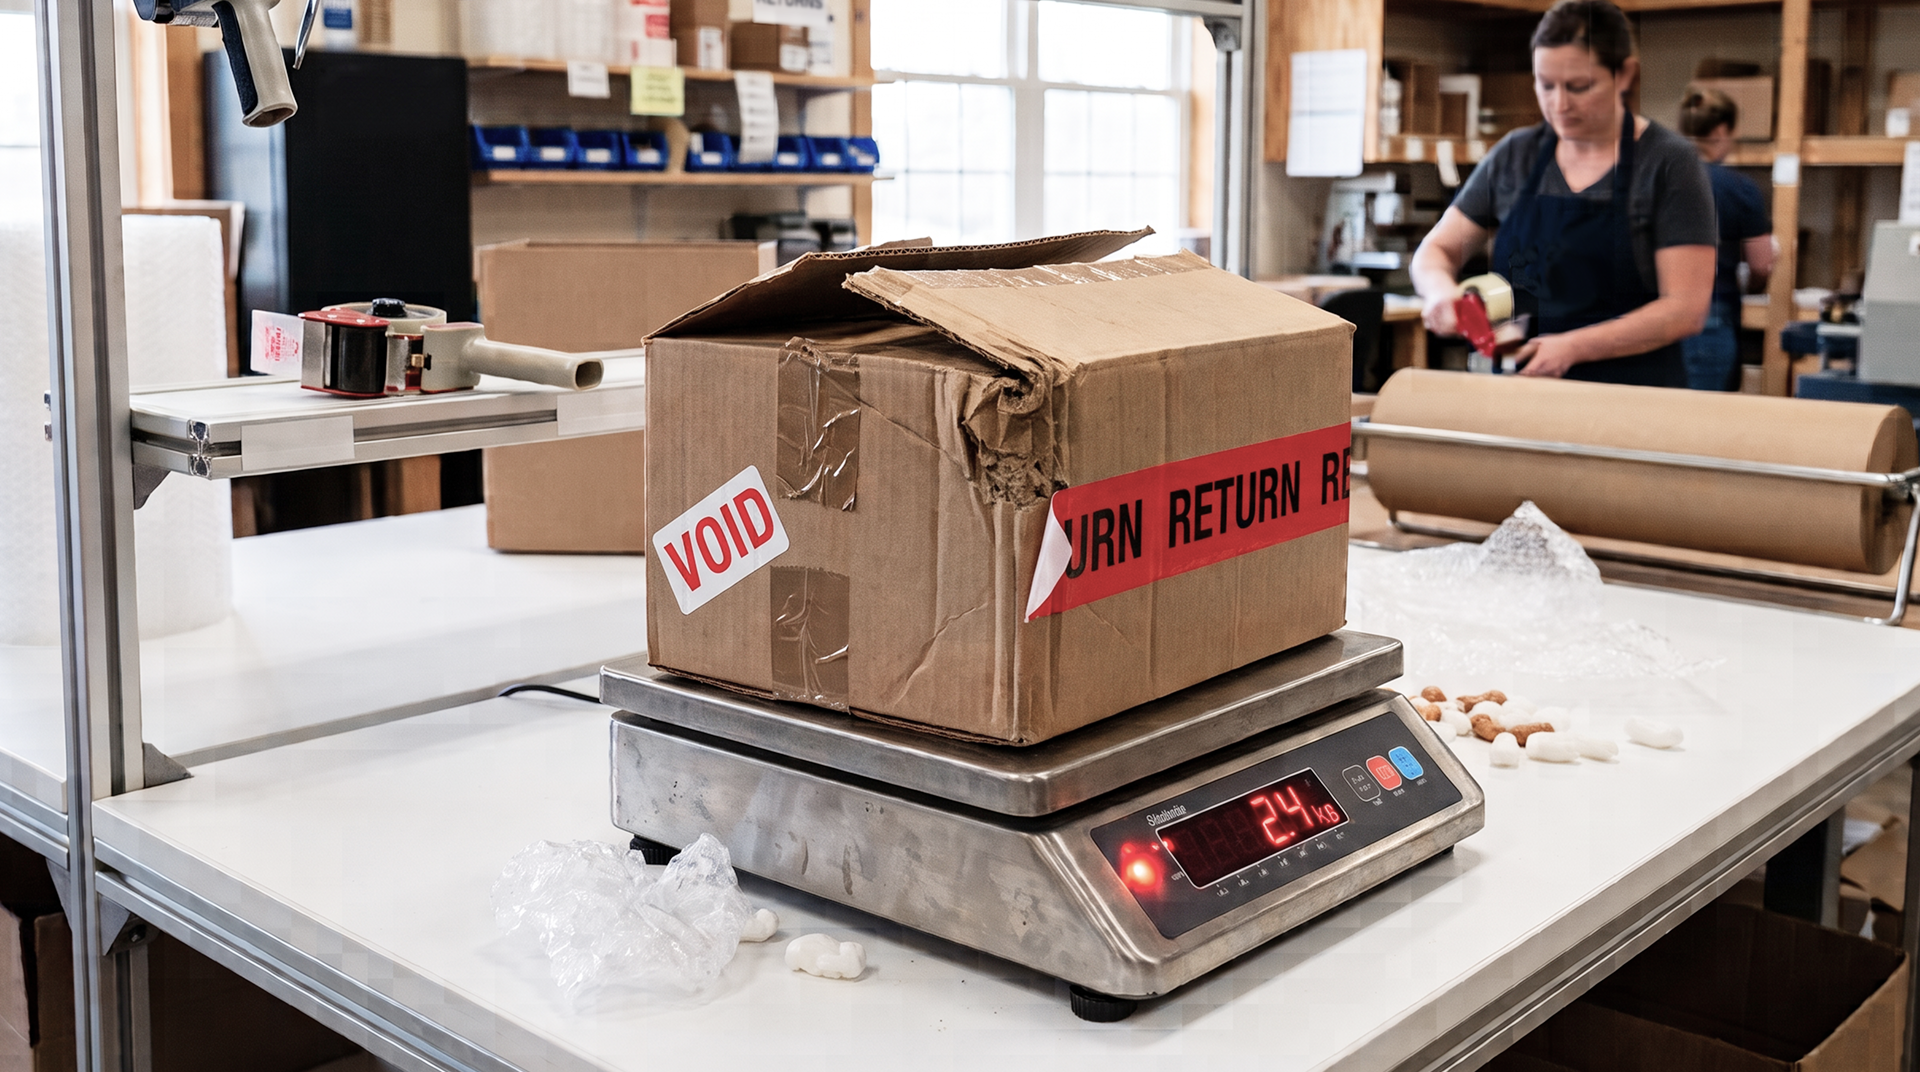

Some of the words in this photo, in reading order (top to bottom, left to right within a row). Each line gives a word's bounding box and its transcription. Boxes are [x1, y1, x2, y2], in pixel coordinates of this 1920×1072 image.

[755, 0, 824, 10] TURNS
[663, 488, 774, 592] VOID
[1169, 460, 1300, 548] RETURN
[1250, 787, 1314, 845] 2.4
